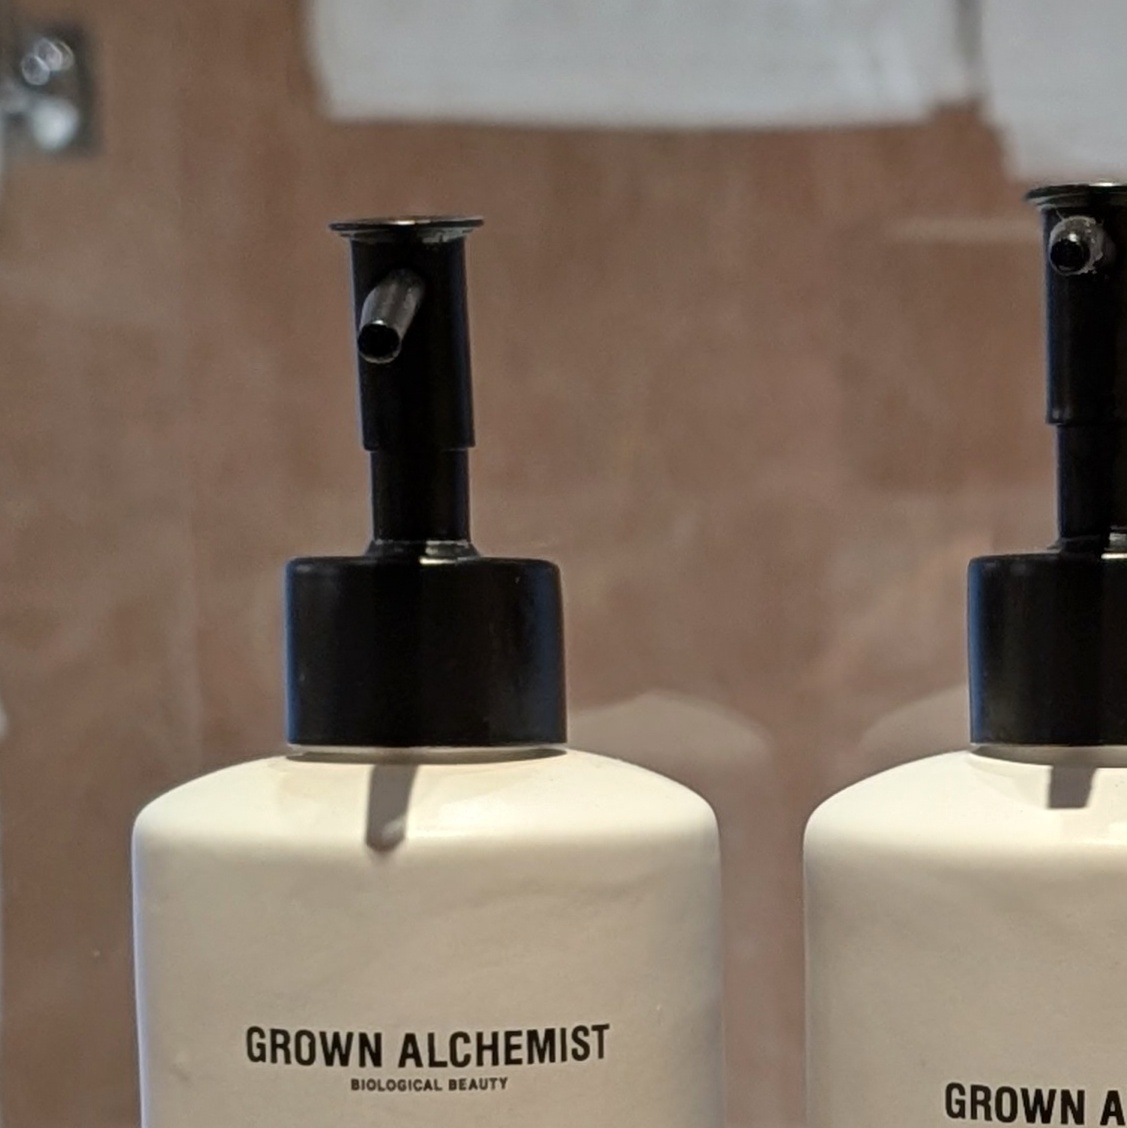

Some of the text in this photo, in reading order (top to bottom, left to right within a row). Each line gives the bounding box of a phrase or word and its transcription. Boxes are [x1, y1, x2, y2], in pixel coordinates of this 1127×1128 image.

[246, 1024, 610, 1068] GROWN ALCHEMIST
[351, 1077, 508, 1091] BIOLOGICAL BEAUTY
[945, 1082, 1085, 1125] GROWN
